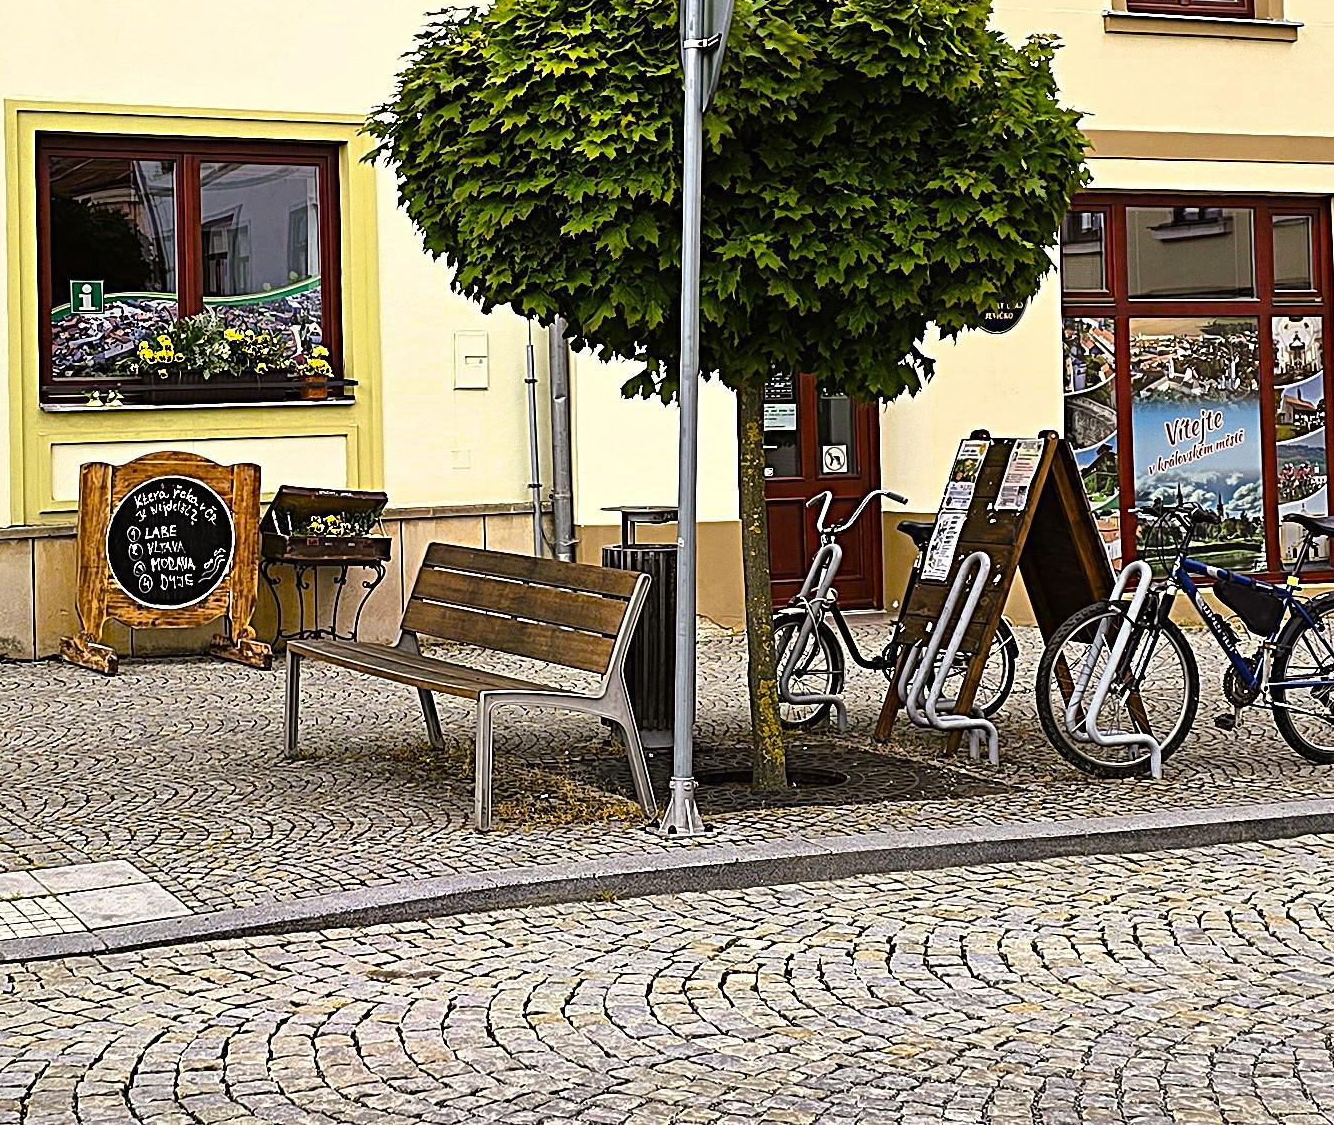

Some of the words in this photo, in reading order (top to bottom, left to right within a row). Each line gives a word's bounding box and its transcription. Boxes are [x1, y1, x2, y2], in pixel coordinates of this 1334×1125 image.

[1165, 409, 1223, 445] Vítejte
[1157, 443, 1214, 472] královském
[144, 524, 177, 540] LABE
[146, 540, 187, 556] VLTAVA
[159, 573, 194, 591] DYJE
